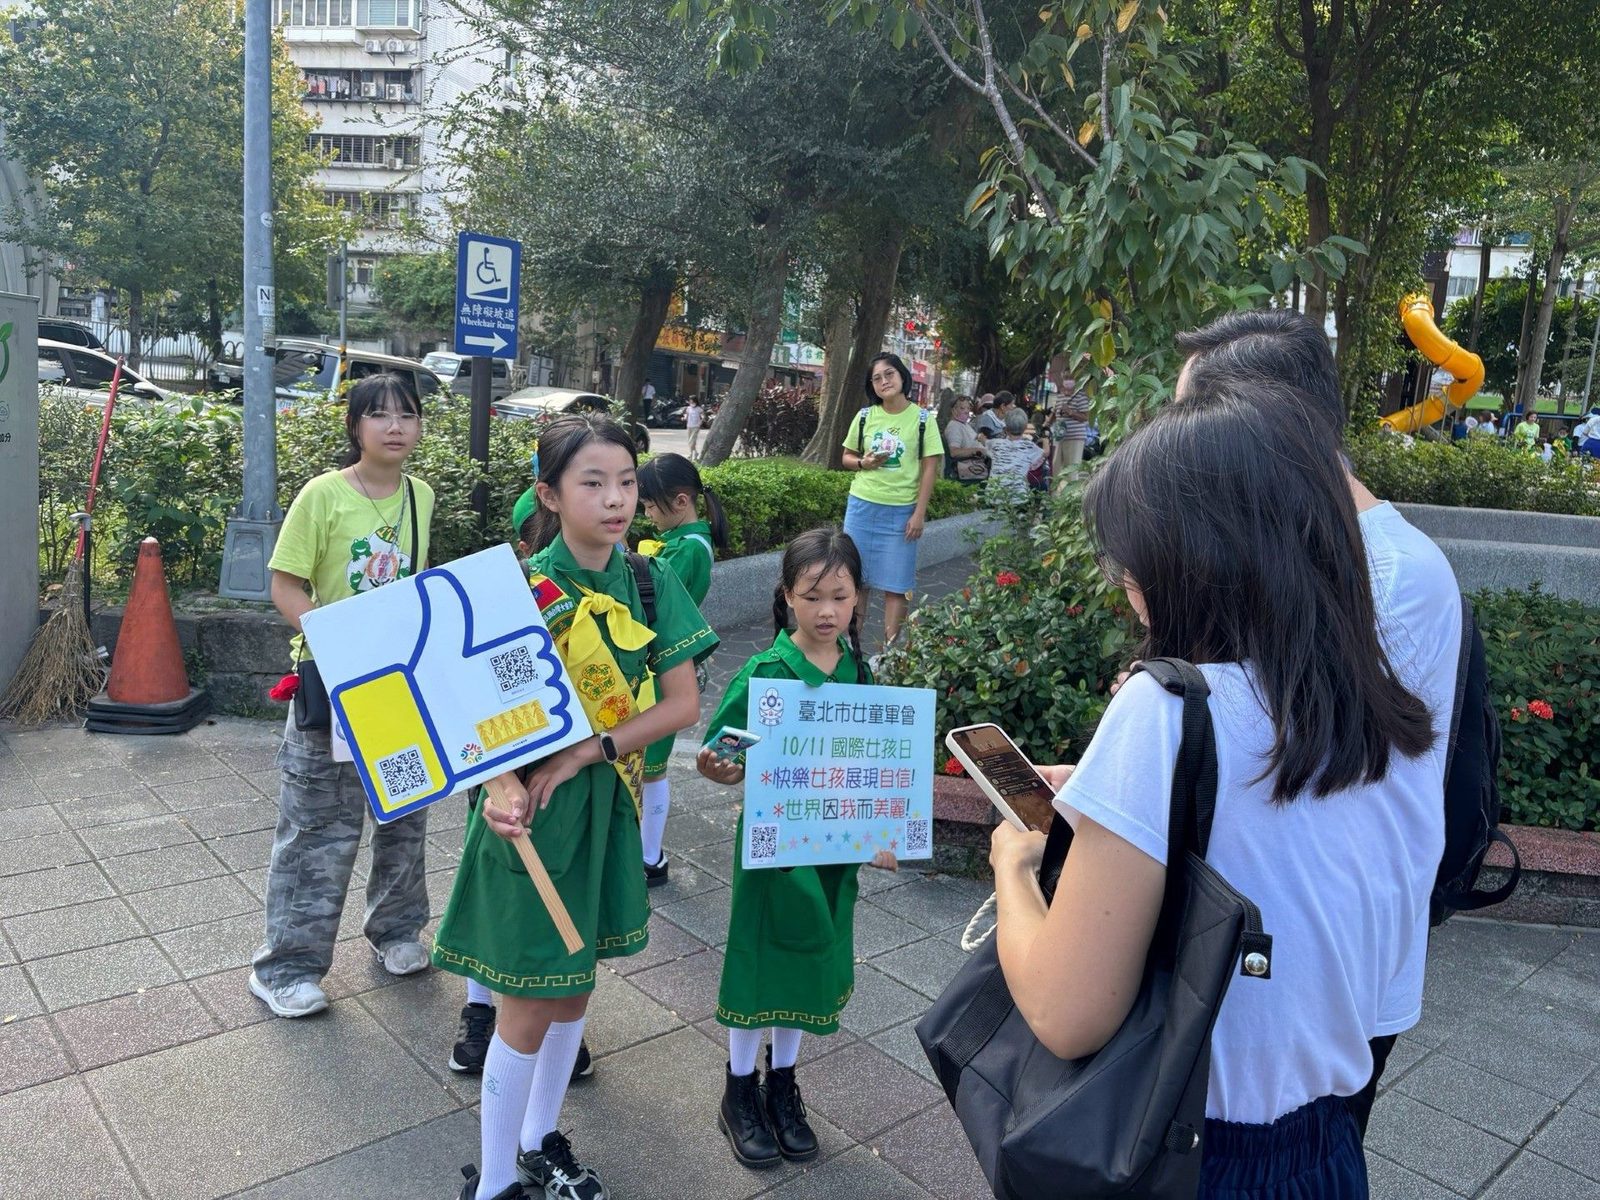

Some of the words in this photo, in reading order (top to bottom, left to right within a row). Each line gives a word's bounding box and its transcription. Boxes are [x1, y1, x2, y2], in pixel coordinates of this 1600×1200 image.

[460, 302, 515, 321] 無障礙坡道
[460, 316, 496, 328] Wheelchair
[496, 320, 515, 332] Ramp
[798, 700, 916, 726] 臺北市女童軍會
[782, 736, 825, 756] 10/11
[831, 737, 912, 760] 國際女孩日
